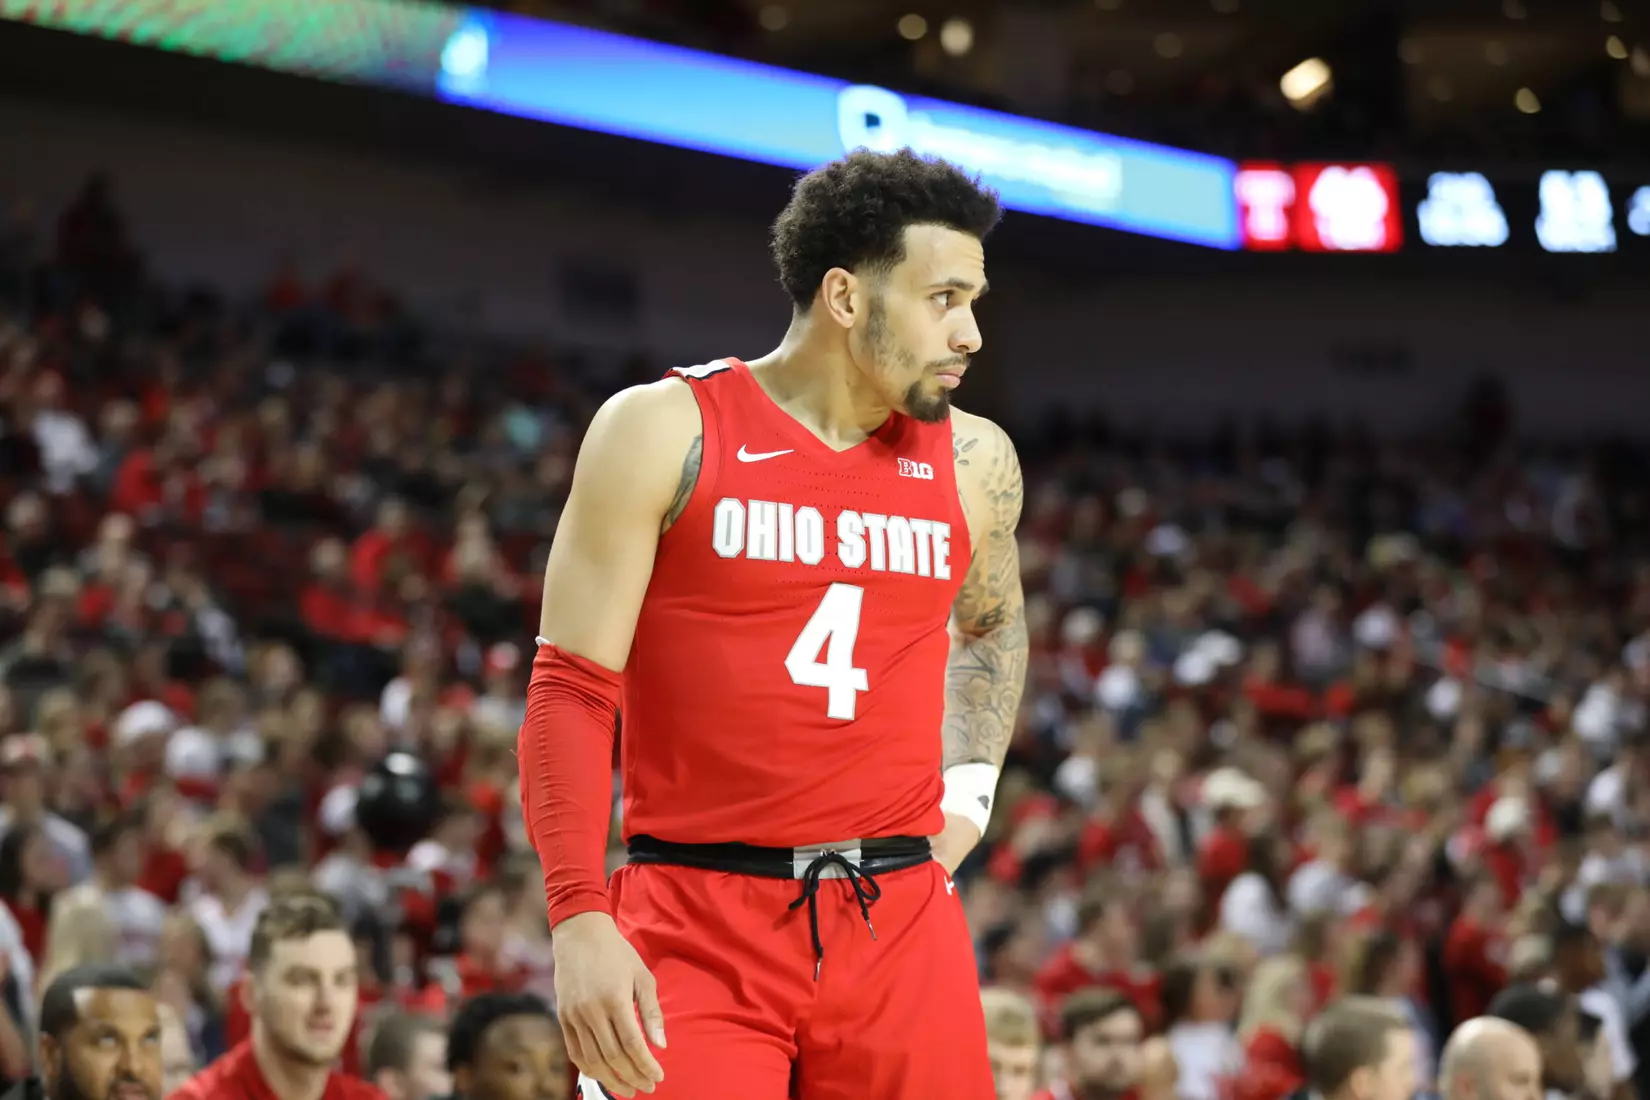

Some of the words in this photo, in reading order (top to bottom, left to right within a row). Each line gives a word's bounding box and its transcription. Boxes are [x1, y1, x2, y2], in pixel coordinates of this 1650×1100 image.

[712, 497, 825, 566] OHIO
[836, 509, 951, 580] STATE
[784, 582, 869, 720] 4
